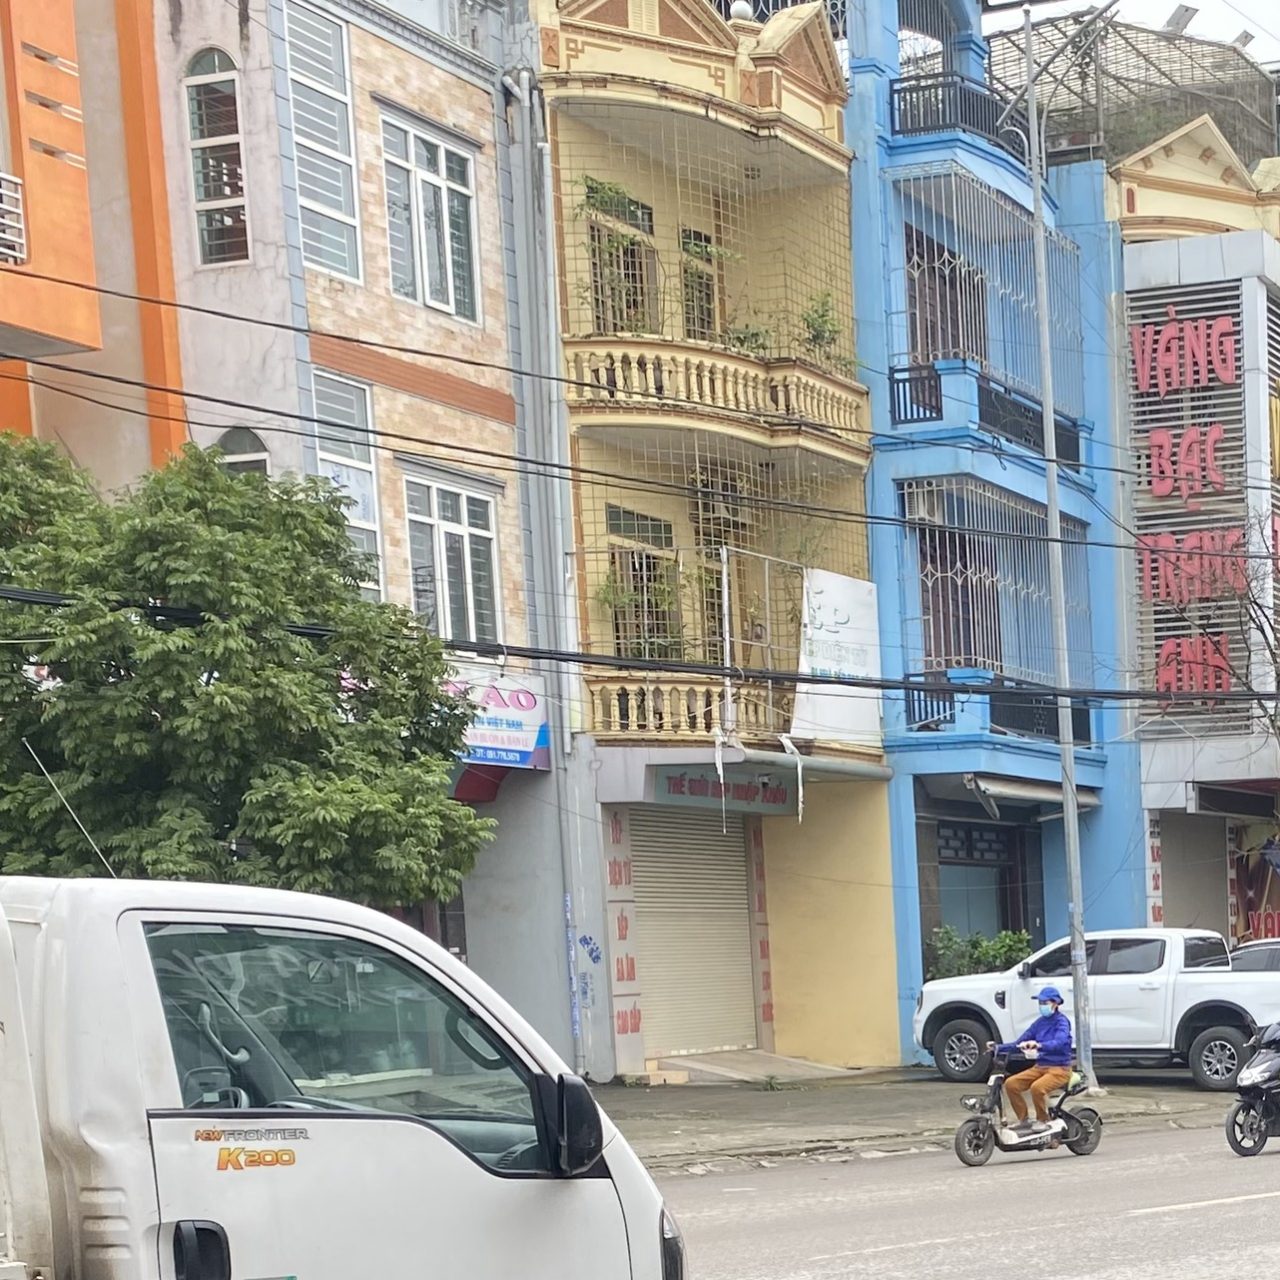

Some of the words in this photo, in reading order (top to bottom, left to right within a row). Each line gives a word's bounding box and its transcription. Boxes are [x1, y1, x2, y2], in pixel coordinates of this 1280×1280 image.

[1131, 305, 1237, 399] VÀNG
[1150, 423, 1225, 511] BẠC
[1136, 528, 1248, 607] TRANG
[1157, 634, 1231, 712] ANH
[216, 1147, 296, 1170] K200
